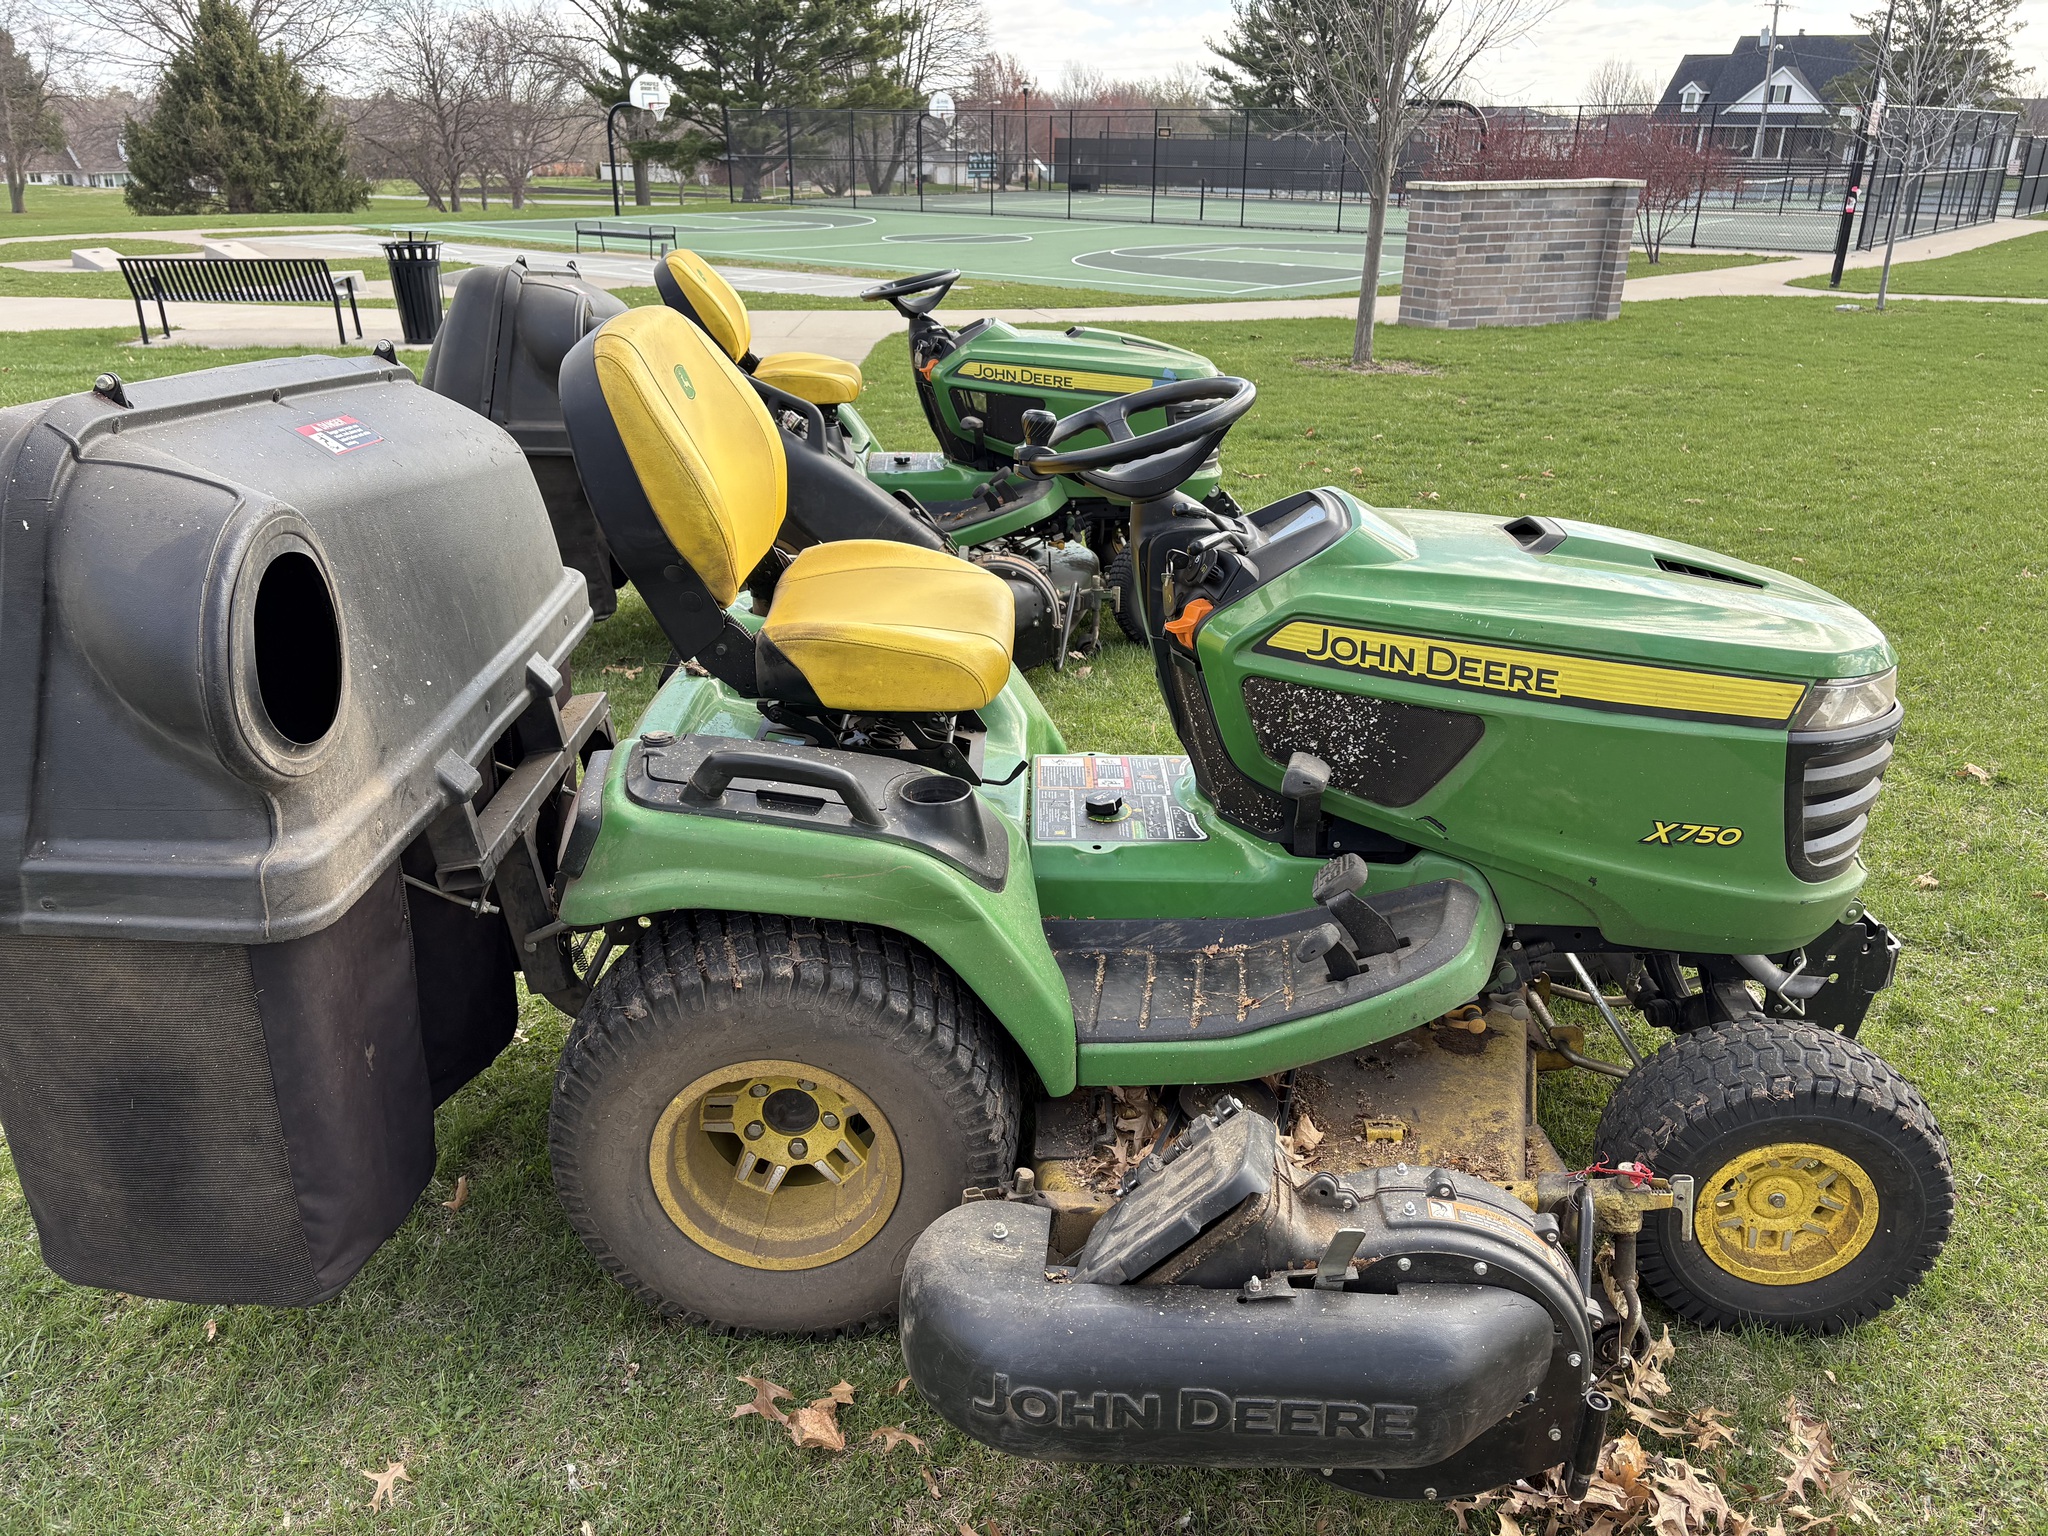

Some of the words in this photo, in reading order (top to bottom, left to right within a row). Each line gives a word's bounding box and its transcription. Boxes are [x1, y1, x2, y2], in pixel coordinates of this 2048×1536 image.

[974, 363, 1017, 382] JOHN
[1020, 369, 1074, 388] DEERE
[1306, 628, 1416, 672] JOHN
[1427, 645, 1560, 695] DEERE
[1639, 820, 1744, 847] X750
[971, 1371, 1162, 1430] JOHN
[1178, 1386, 1419, 1441] DEERE
